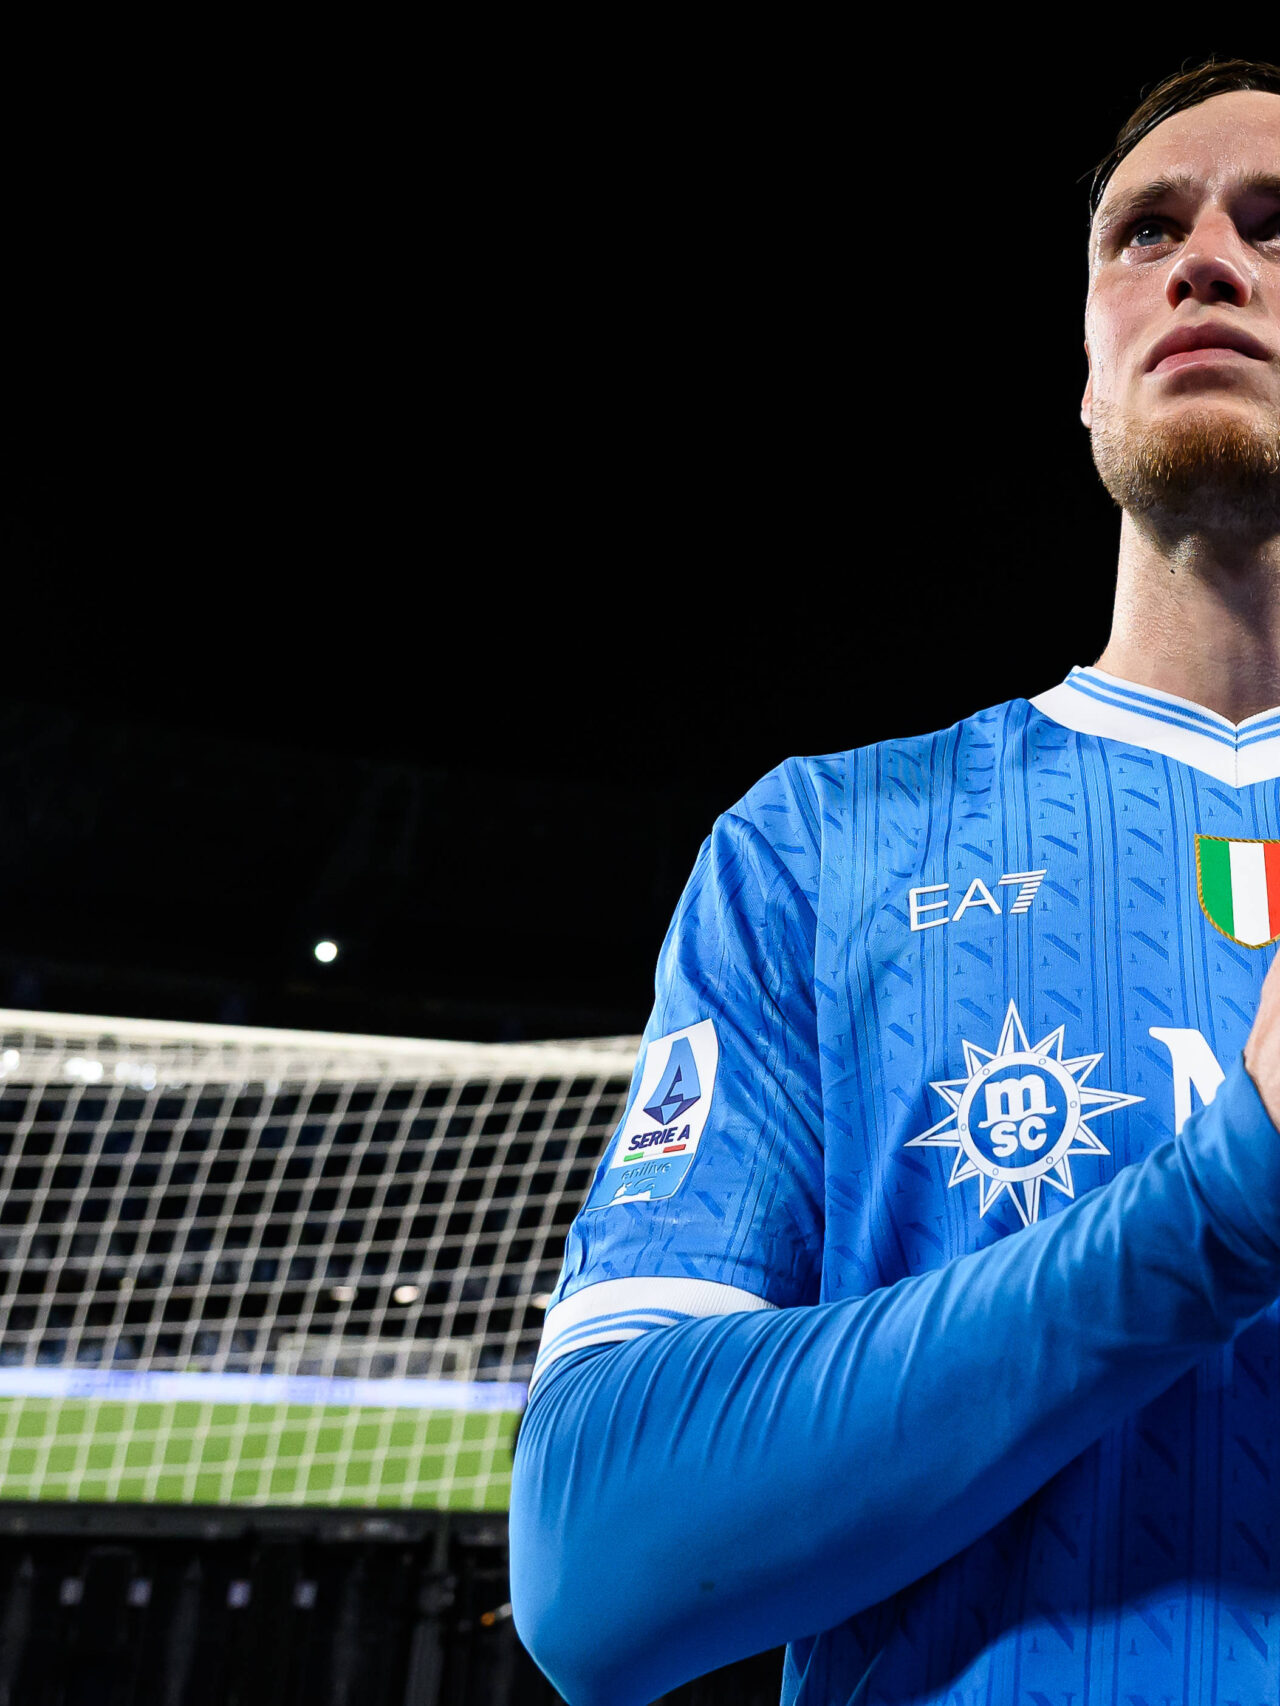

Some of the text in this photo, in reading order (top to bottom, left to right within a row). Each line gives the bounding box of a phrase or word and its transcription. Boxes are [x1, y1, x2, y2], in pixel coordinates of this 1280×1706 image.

[909, 869, 1047, 931] EA7
[628, 1124, 690, 1151] SERIE A
[621, 1161, 672, 1180] enilive
